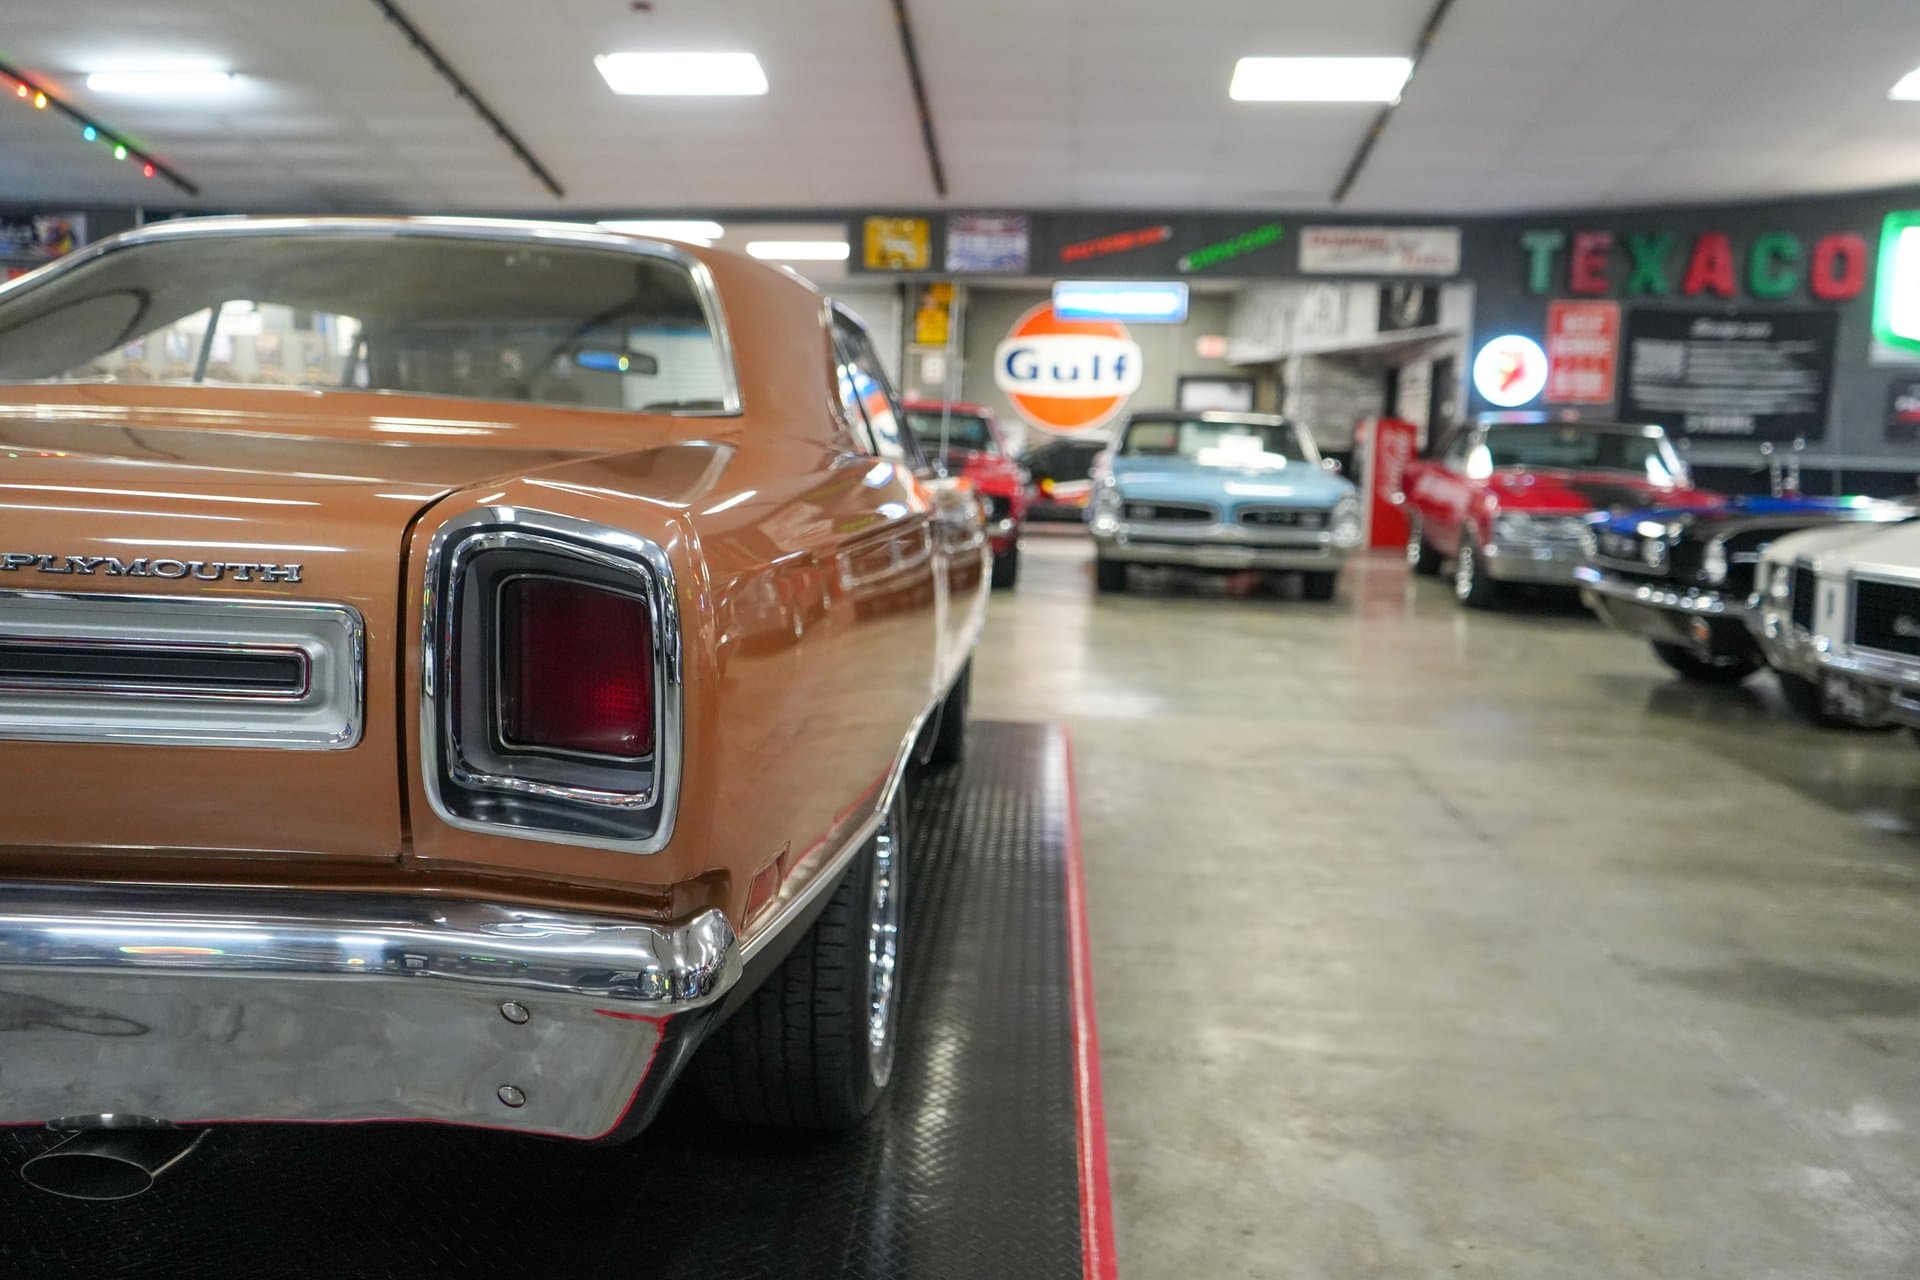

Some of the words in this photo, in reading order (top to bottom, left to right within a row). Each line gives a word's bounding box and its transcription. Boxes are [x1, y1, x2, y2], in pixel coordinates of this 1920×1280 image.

[1522, 230, 1866, 299] TEXACO
[1006, 349, 1126, 381] Gulf
[1, 553, 302, 583] PLYMOUTH
